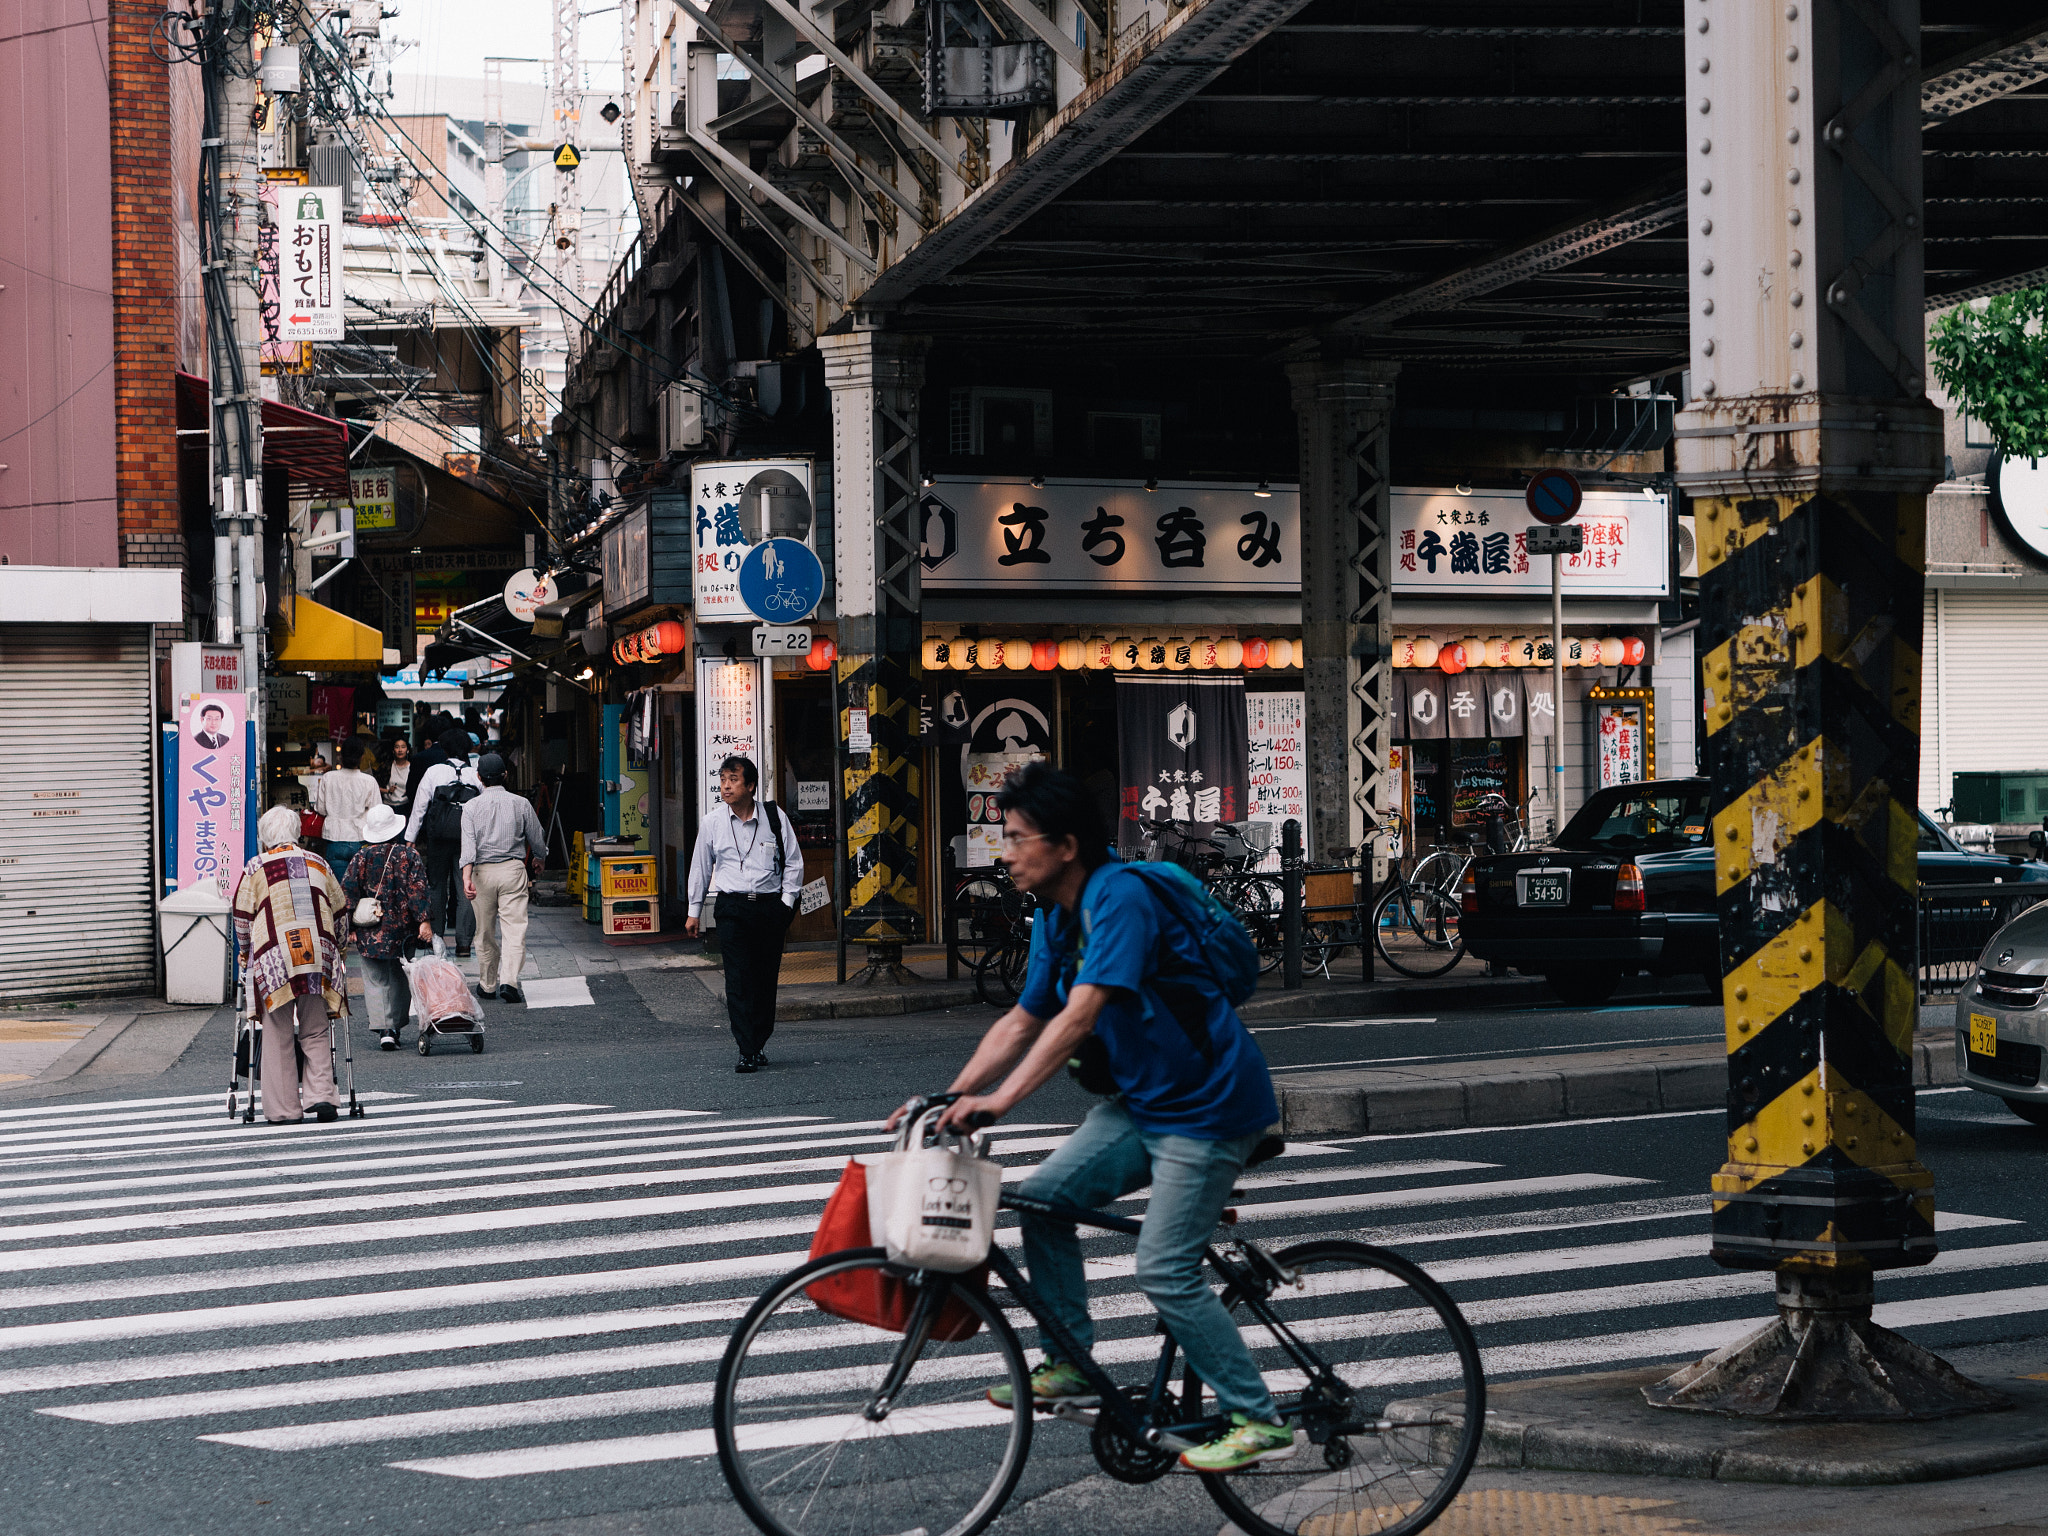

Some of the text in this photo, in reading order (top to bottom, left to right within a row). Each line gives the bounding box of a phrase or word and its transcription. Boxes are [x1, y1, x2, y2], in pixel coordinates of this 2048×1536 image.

[302, 203, 319, 219] 質
[292, 224, 315, 297] おもて
[522, 368, 544, 387] 60
[522, 394, 545, 414] 55
[1436, 509, 1491, 526] 大衆立呑
[998, 502, 1283, 568] 立ち呑み
[1528, 528, 1581, 539] 自動車
[1399, 529, 1530, 575] 酒処 千歳屋 天満
[1528, 539, 1581, 551] ここから
[1568, 549, 1622, 569] あります
[515, 606, 528, 614] Bar
[756, 633, 808, 650] 7-22
[204, 655, 238, 671] 天四北商店街
[215, 674, 238, 690] 駅前通り
[1274, 738, 1302, 752] 420円
[229, 754, 242, 831] 大阪府議会議員
[1257, 787, 1281, 801] 酎ハイ
[1267, 803, 1288, 815] 生ビール
[614, 878, 648, 889] KIRIN
[1534, 887, 1563, 900] 54-50
[614, 917, 650, 926] アサヒビール
